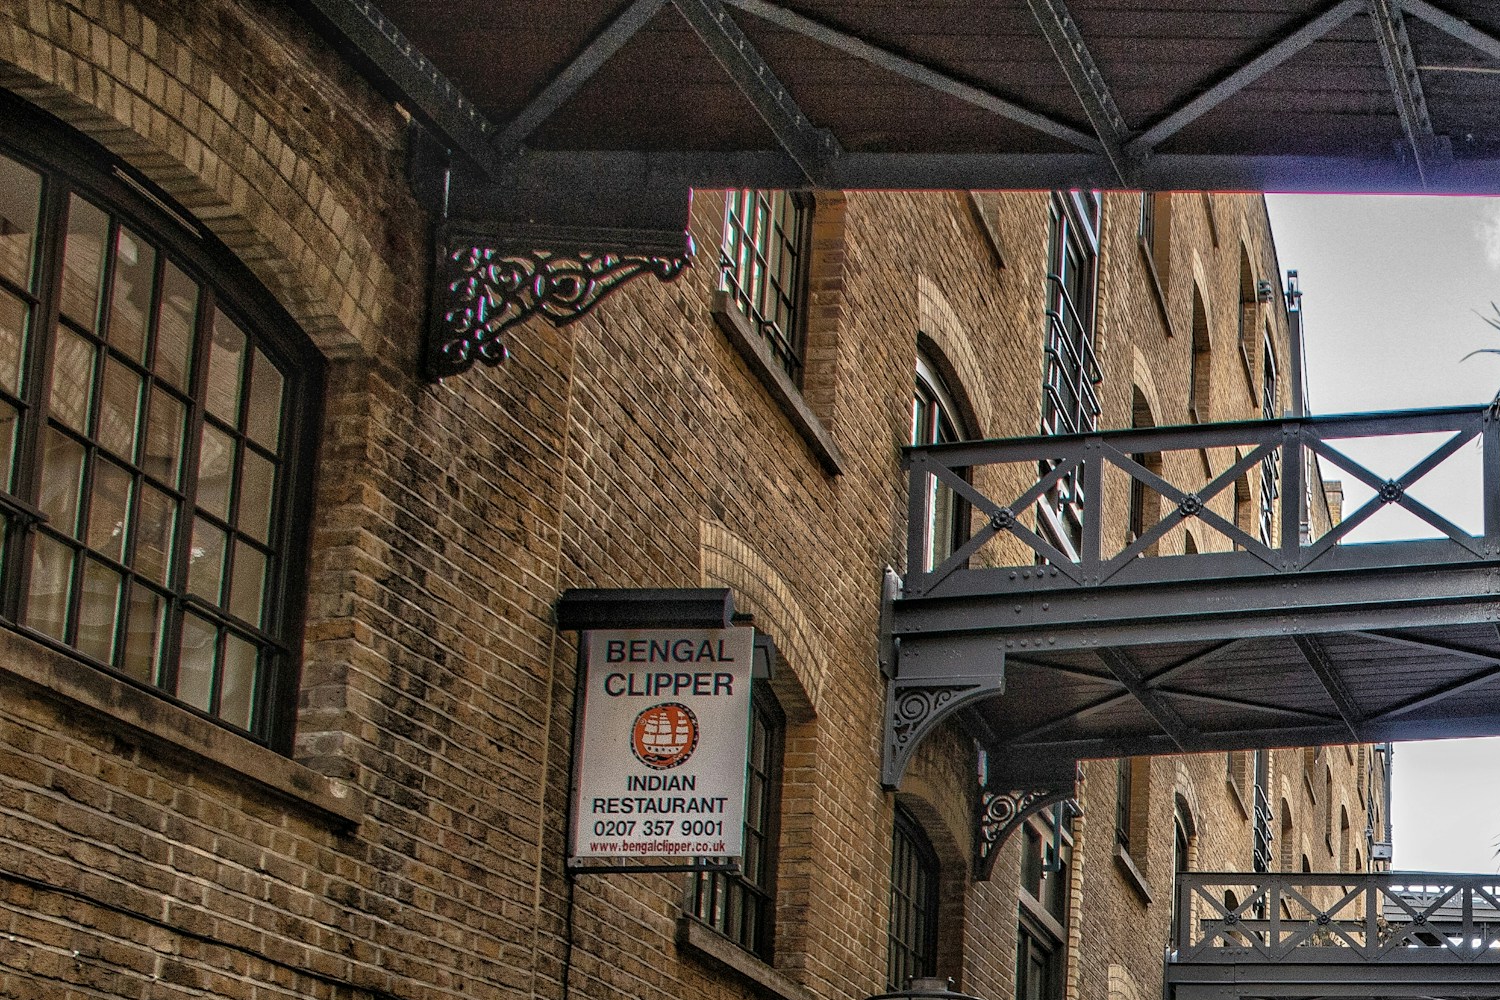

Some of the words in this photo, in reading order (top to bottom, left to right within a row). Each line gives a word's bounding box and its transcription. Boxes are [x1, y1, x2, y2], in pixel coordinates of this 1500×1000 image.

[605, 639, 735, 663] BENGAL
[604, 672, 734, 697] CLIPPER
[627, 775, 696, 791] INDIAN
[592, 797, 728, 814] RESTAURANT
[594, 820, 636, 836] 0207
[643, 820, 674, 836] 357
[681, 820, 724, 836] 9001
[590, 840, 725, 855] www.bengalclipper.co.uk
